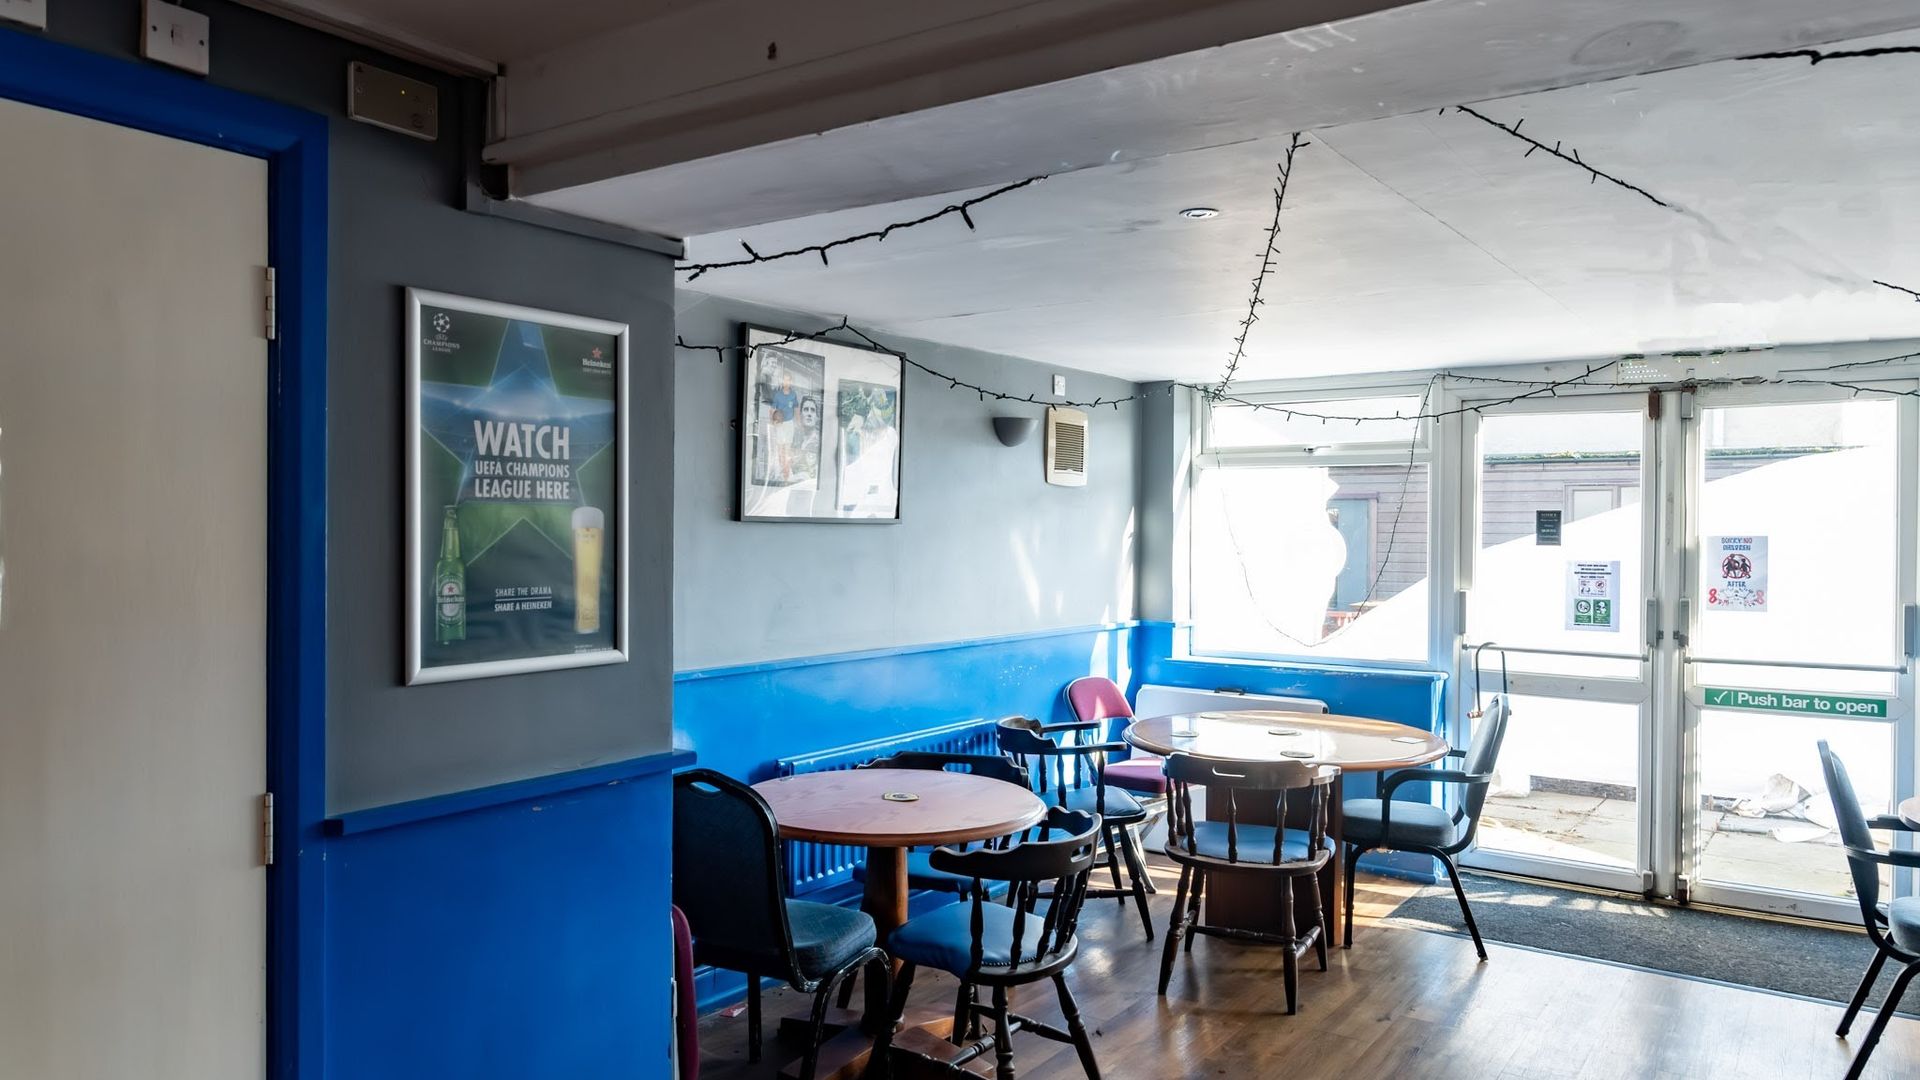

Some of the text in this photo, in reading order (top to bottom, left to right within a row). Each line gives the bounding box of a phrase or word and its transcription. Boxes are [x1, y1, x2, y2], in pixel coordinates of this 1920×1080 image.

[423, 339, 460, 349] CHAMPIONS
[474, 420, 569, 460] WATCH
[475, 461, 570, 478] UEFA CHAMPIONS
[475, 479, 570, 499] LEAGUE HERE
[495, 585, 552, 597] SHARE THE DRAMA
[1708, 588, 1718, 604] 8
[494, 600, 552, 612] SHARE A HEINEKEN
[1737, 691, 1879, 714] Push bar to open
